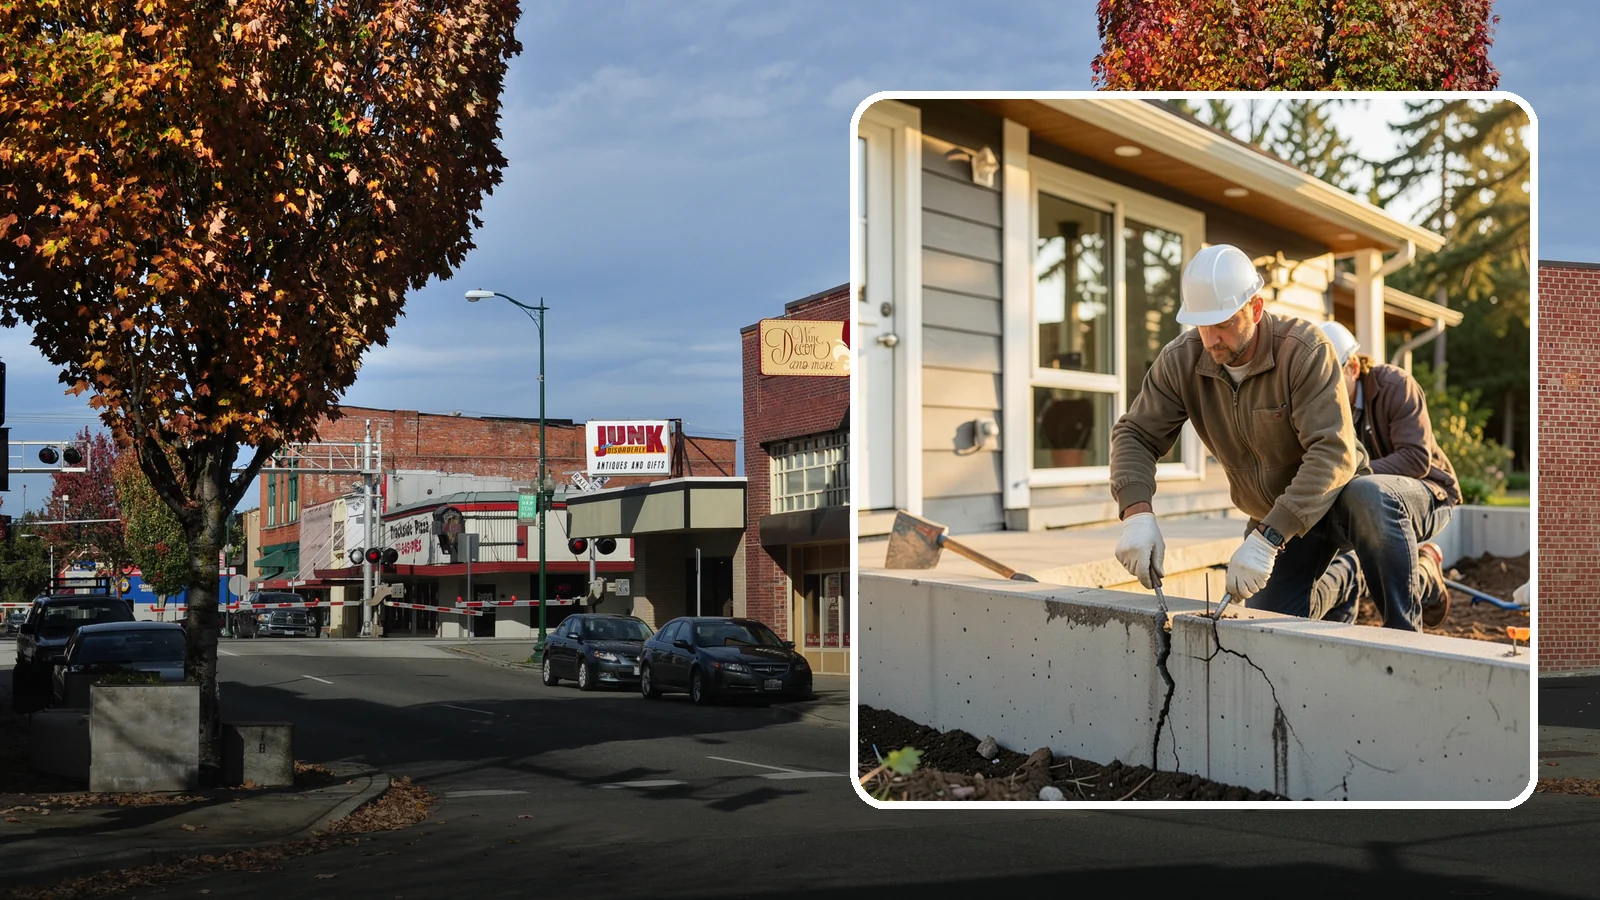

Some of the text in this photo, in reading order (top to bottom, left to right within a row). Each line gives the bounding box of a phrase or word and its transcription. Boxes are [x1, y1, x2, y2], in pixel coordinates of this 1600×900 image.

[765, 328, 831, 365] Decor
[595, 425, 665, 457] JUNK
[607, 446, 645, 454] DISORDERLY
[597, 460, 665, 470] ANTIQUES AND GIFTS
[573, 473, 589, 492] RAIL
[414, 519, 429, 535] Pizza
